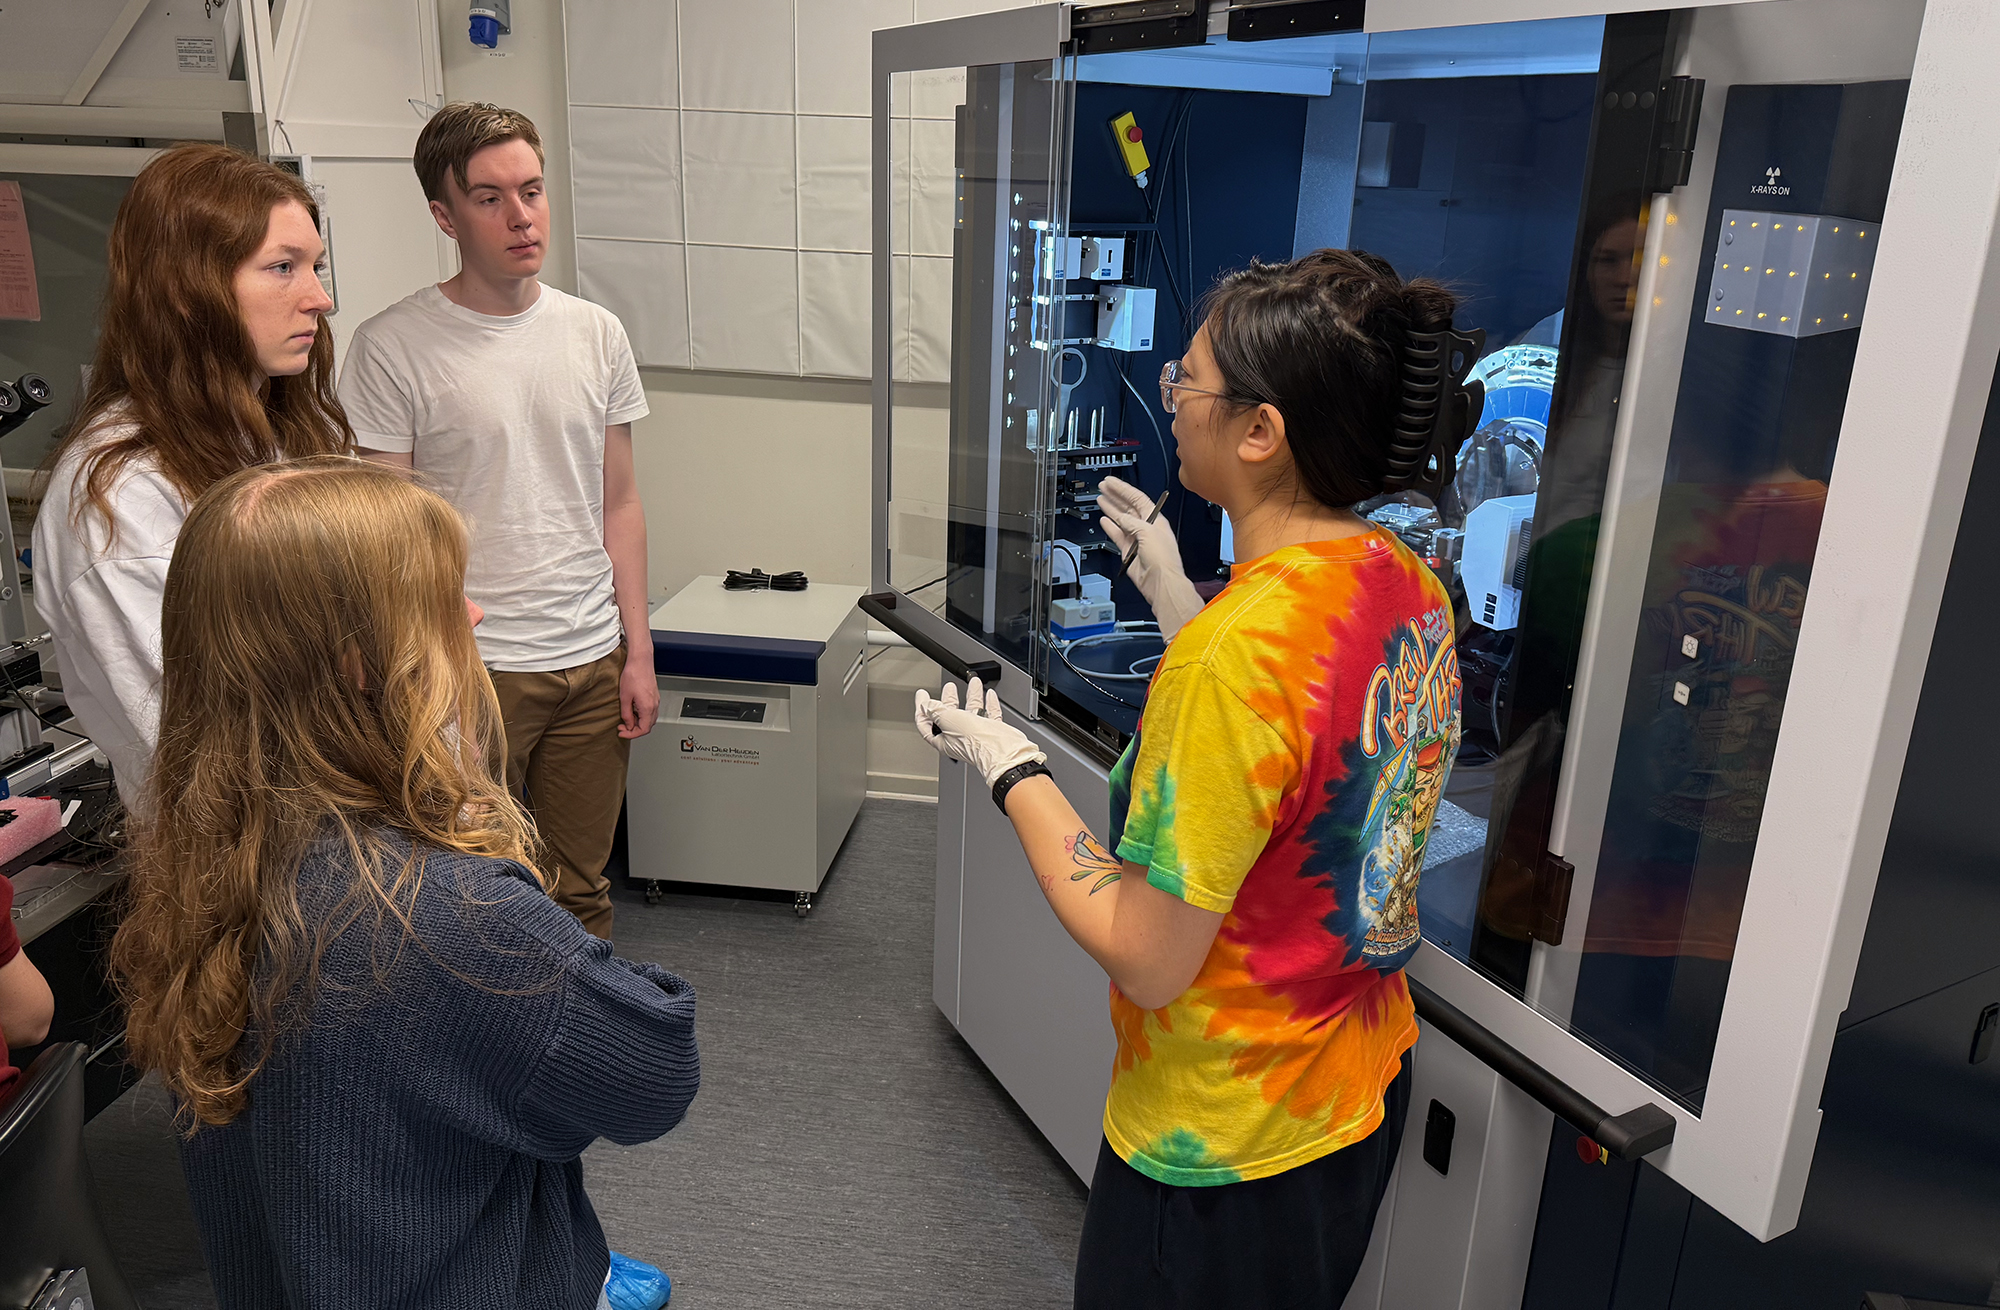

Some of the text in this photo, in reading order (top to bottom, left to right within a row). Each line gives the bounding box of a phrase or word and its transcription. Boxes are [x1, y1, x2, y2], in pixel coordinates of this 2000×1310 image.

[1750, 185, 1790, 196] X-RAYS ON
[1361, 617, 1429, 760] BREW
[1417, 629, 1463, 733] THR
